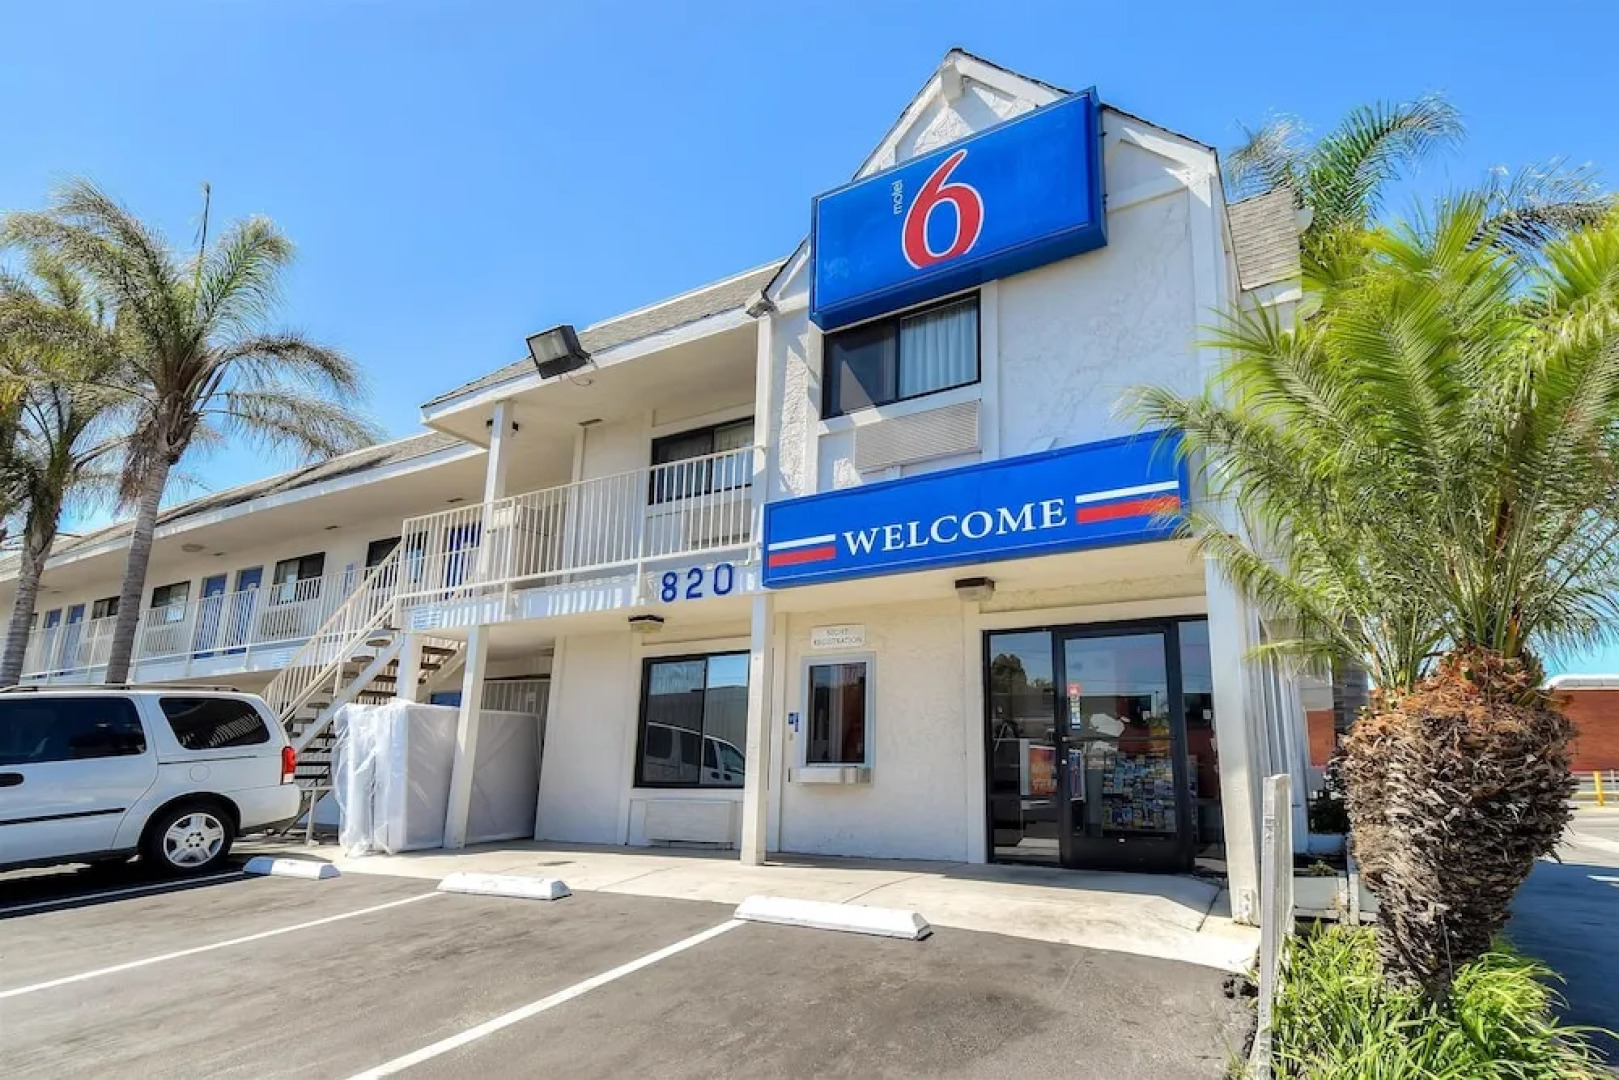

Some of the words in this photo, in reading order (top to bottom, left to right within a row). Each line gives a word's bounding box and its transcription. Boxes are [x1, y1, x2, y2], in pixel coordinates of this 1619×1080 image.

[891, 180, 903, 215] motel
[902, 149, 985, 270] 6
[843, 498, 1067, 556] WELCOME
[661, 563, 734, 602] 820
